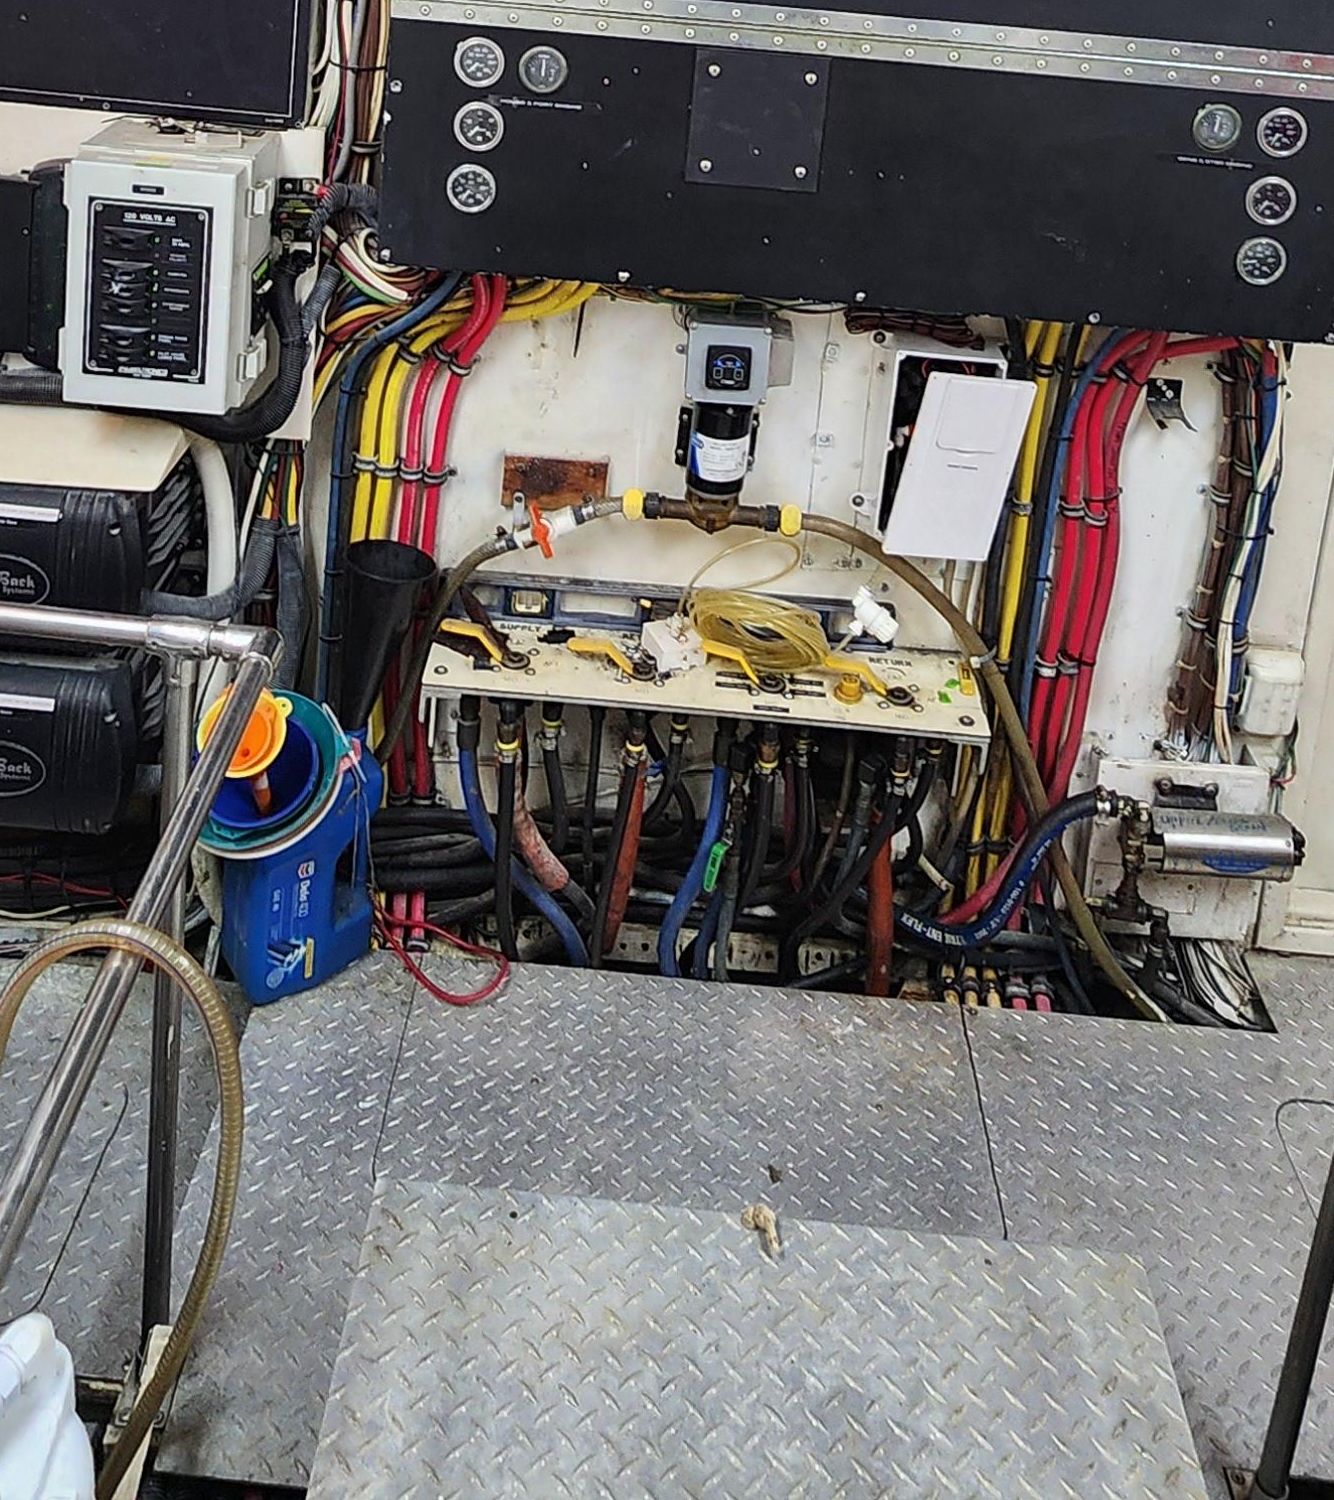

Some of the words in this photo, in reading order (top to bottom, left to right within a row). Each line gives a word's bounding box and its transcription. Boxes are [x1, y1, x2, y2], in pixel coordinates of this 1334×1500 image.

[123, 212, 137, 220] 120
[139, 213, 163, 222] VOLTS
[164, 215, 177, 224] AC
[2, 585, 36, 597] Systems
[499, 622, 542, 633] SUPPLY
[868, 656, 913, 668] RETURN
[0, 772, 32, 782] Systems
[299, 879, 311, 903] Delo
